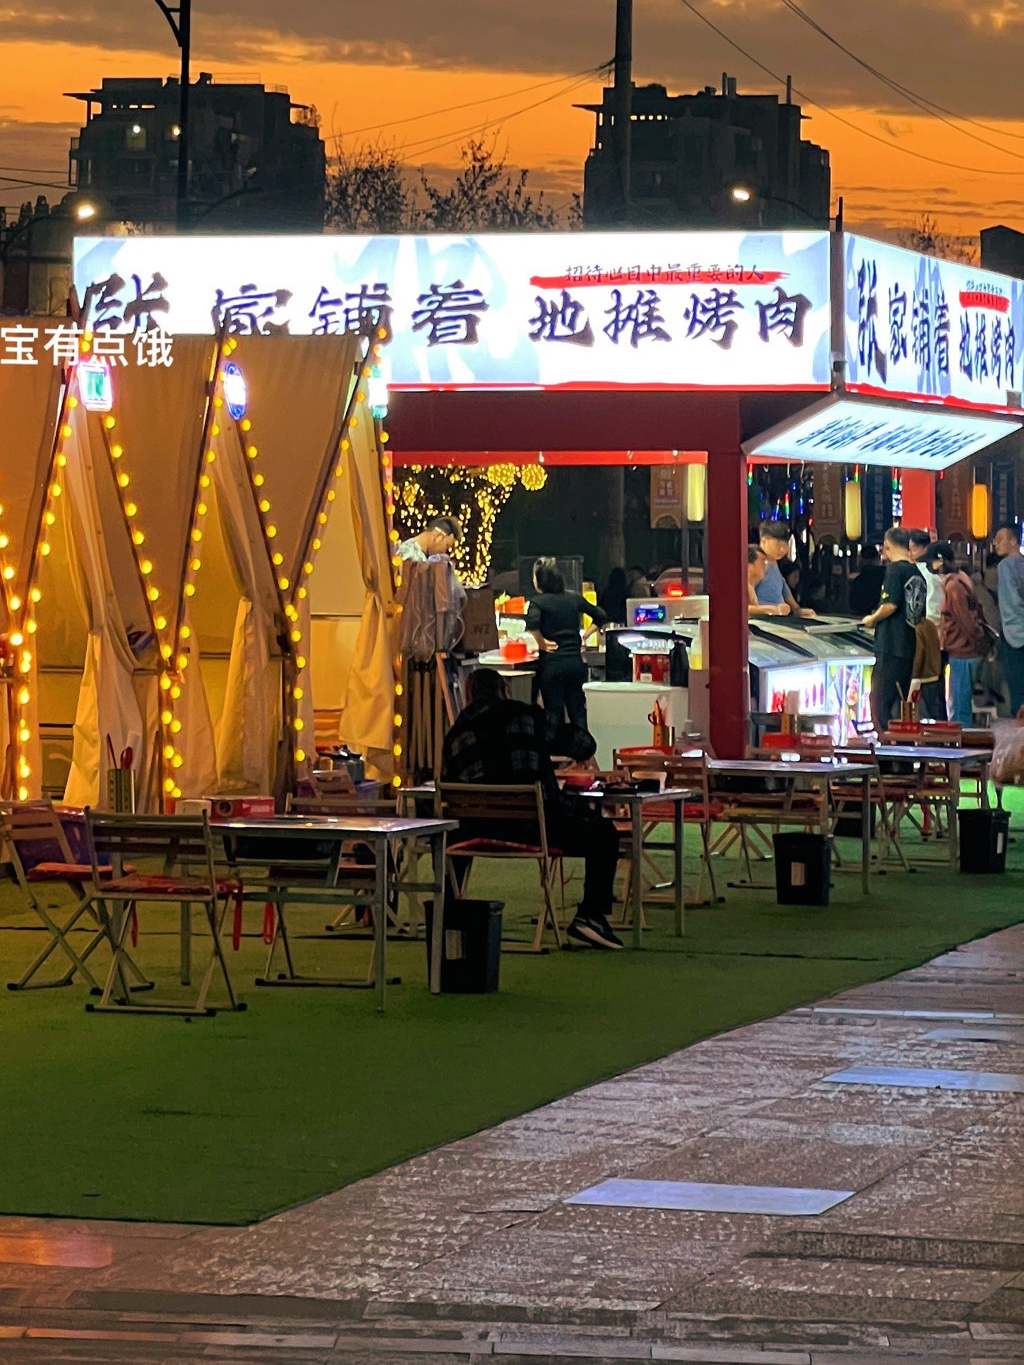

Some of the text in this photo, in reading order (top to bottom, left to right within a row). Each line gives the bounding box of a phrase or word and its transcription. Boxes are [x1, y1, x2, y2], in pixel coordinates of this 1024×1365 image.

[565, 263, 765, 284] 招待心目中最重要的人
